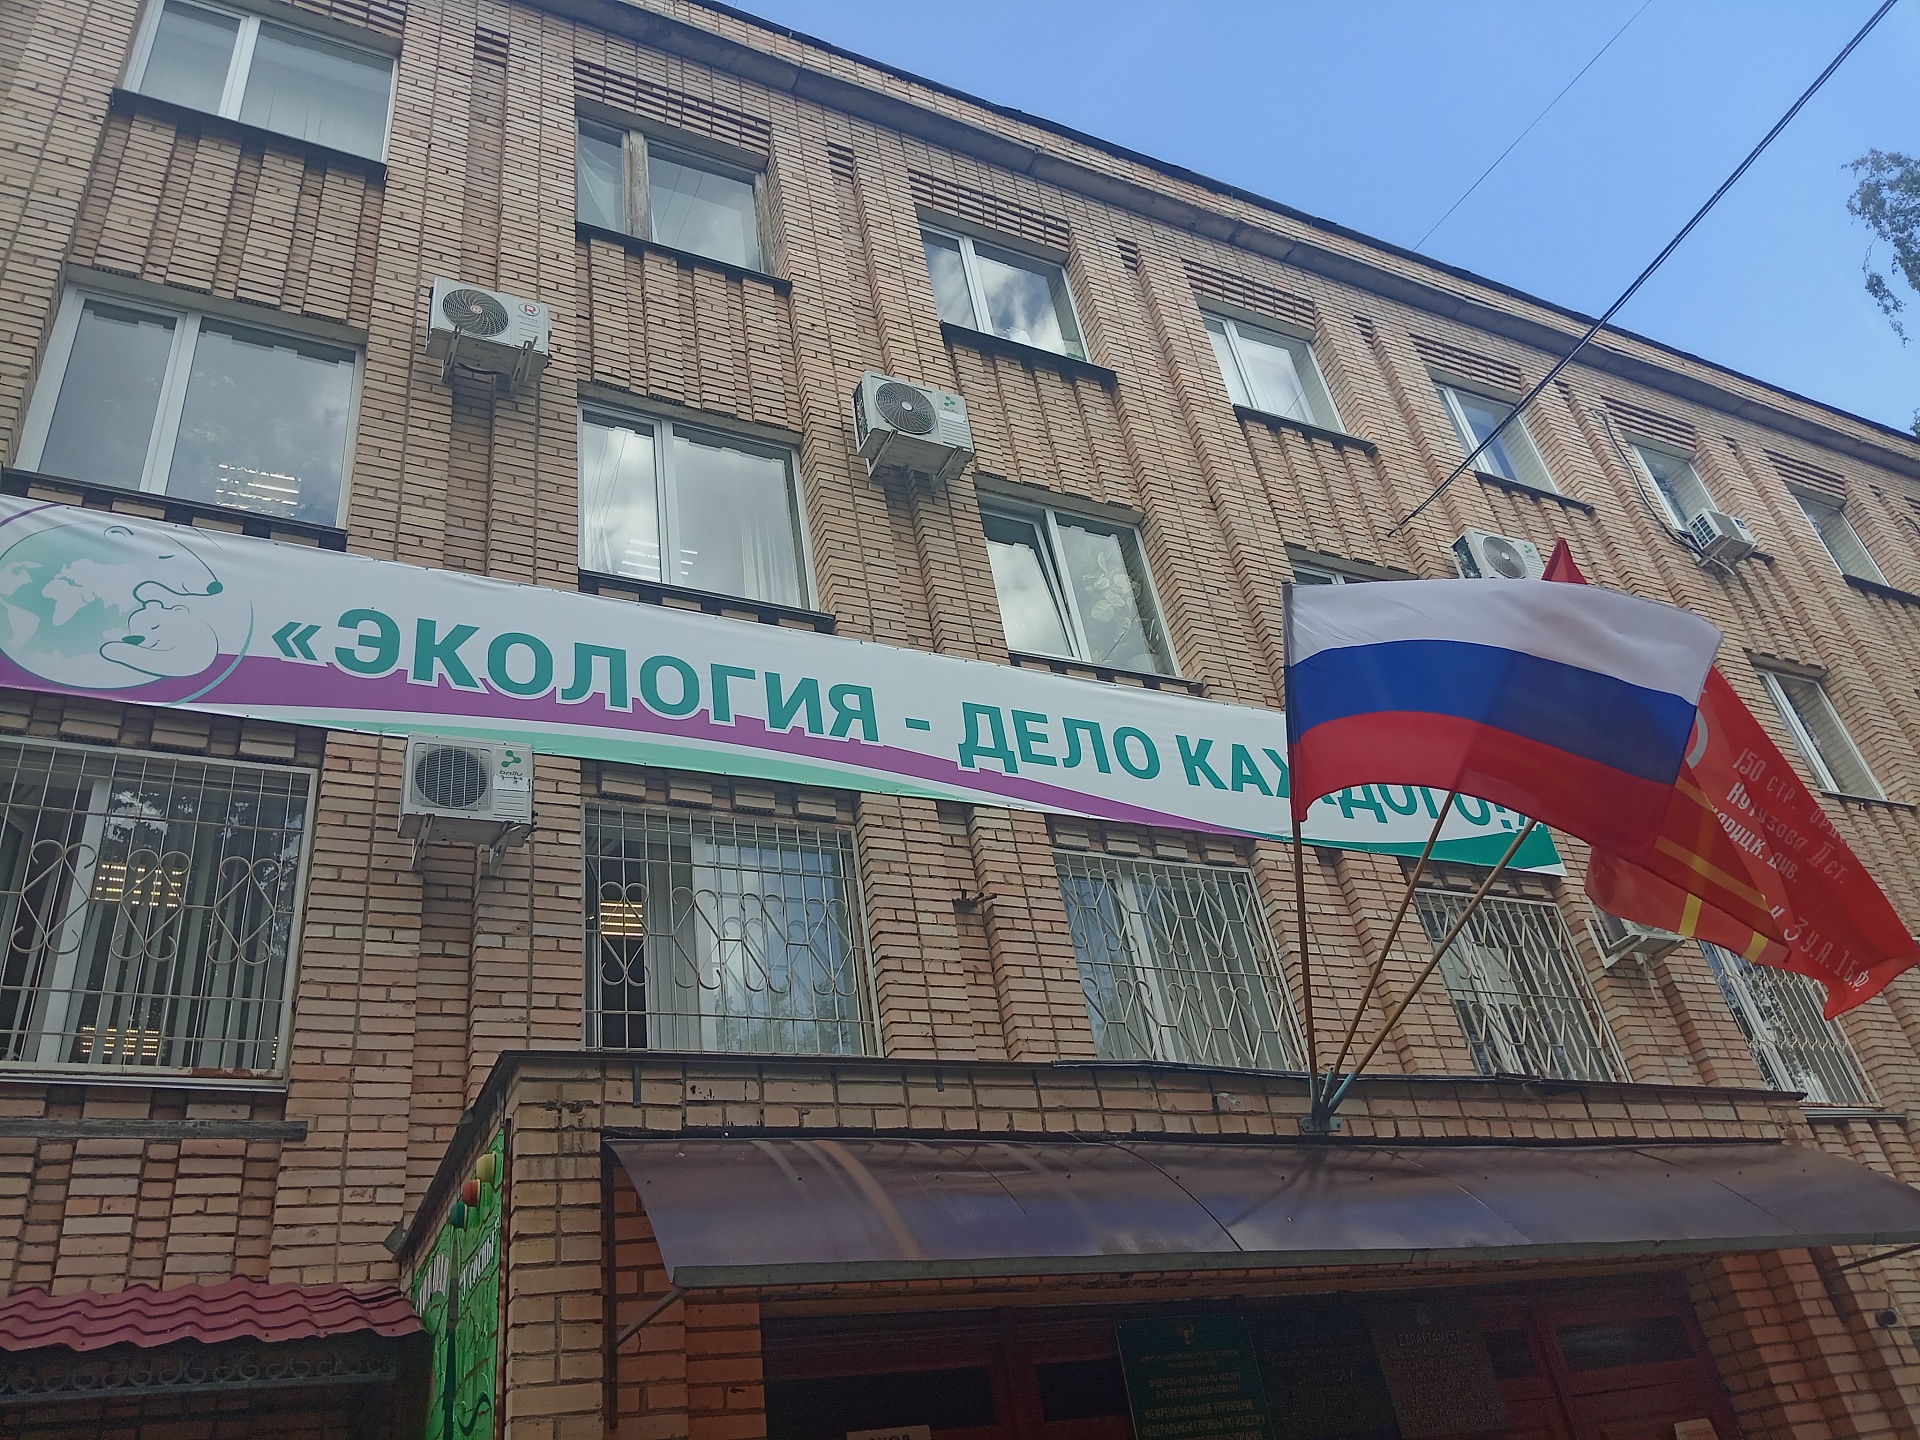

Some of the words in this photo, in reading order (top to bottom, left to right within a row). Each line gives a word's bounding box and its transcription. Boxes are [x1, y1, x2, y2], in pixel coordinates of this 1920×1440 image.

[273, 608, 879, 742] «ЭКОЛОГИЯ
[905, 717, 931, 731] -
[957, 701, 1161, 780] ДЕЛО
[1732, 747, 1767, 782] 150
[1783, 916, 1809, 941] 3
